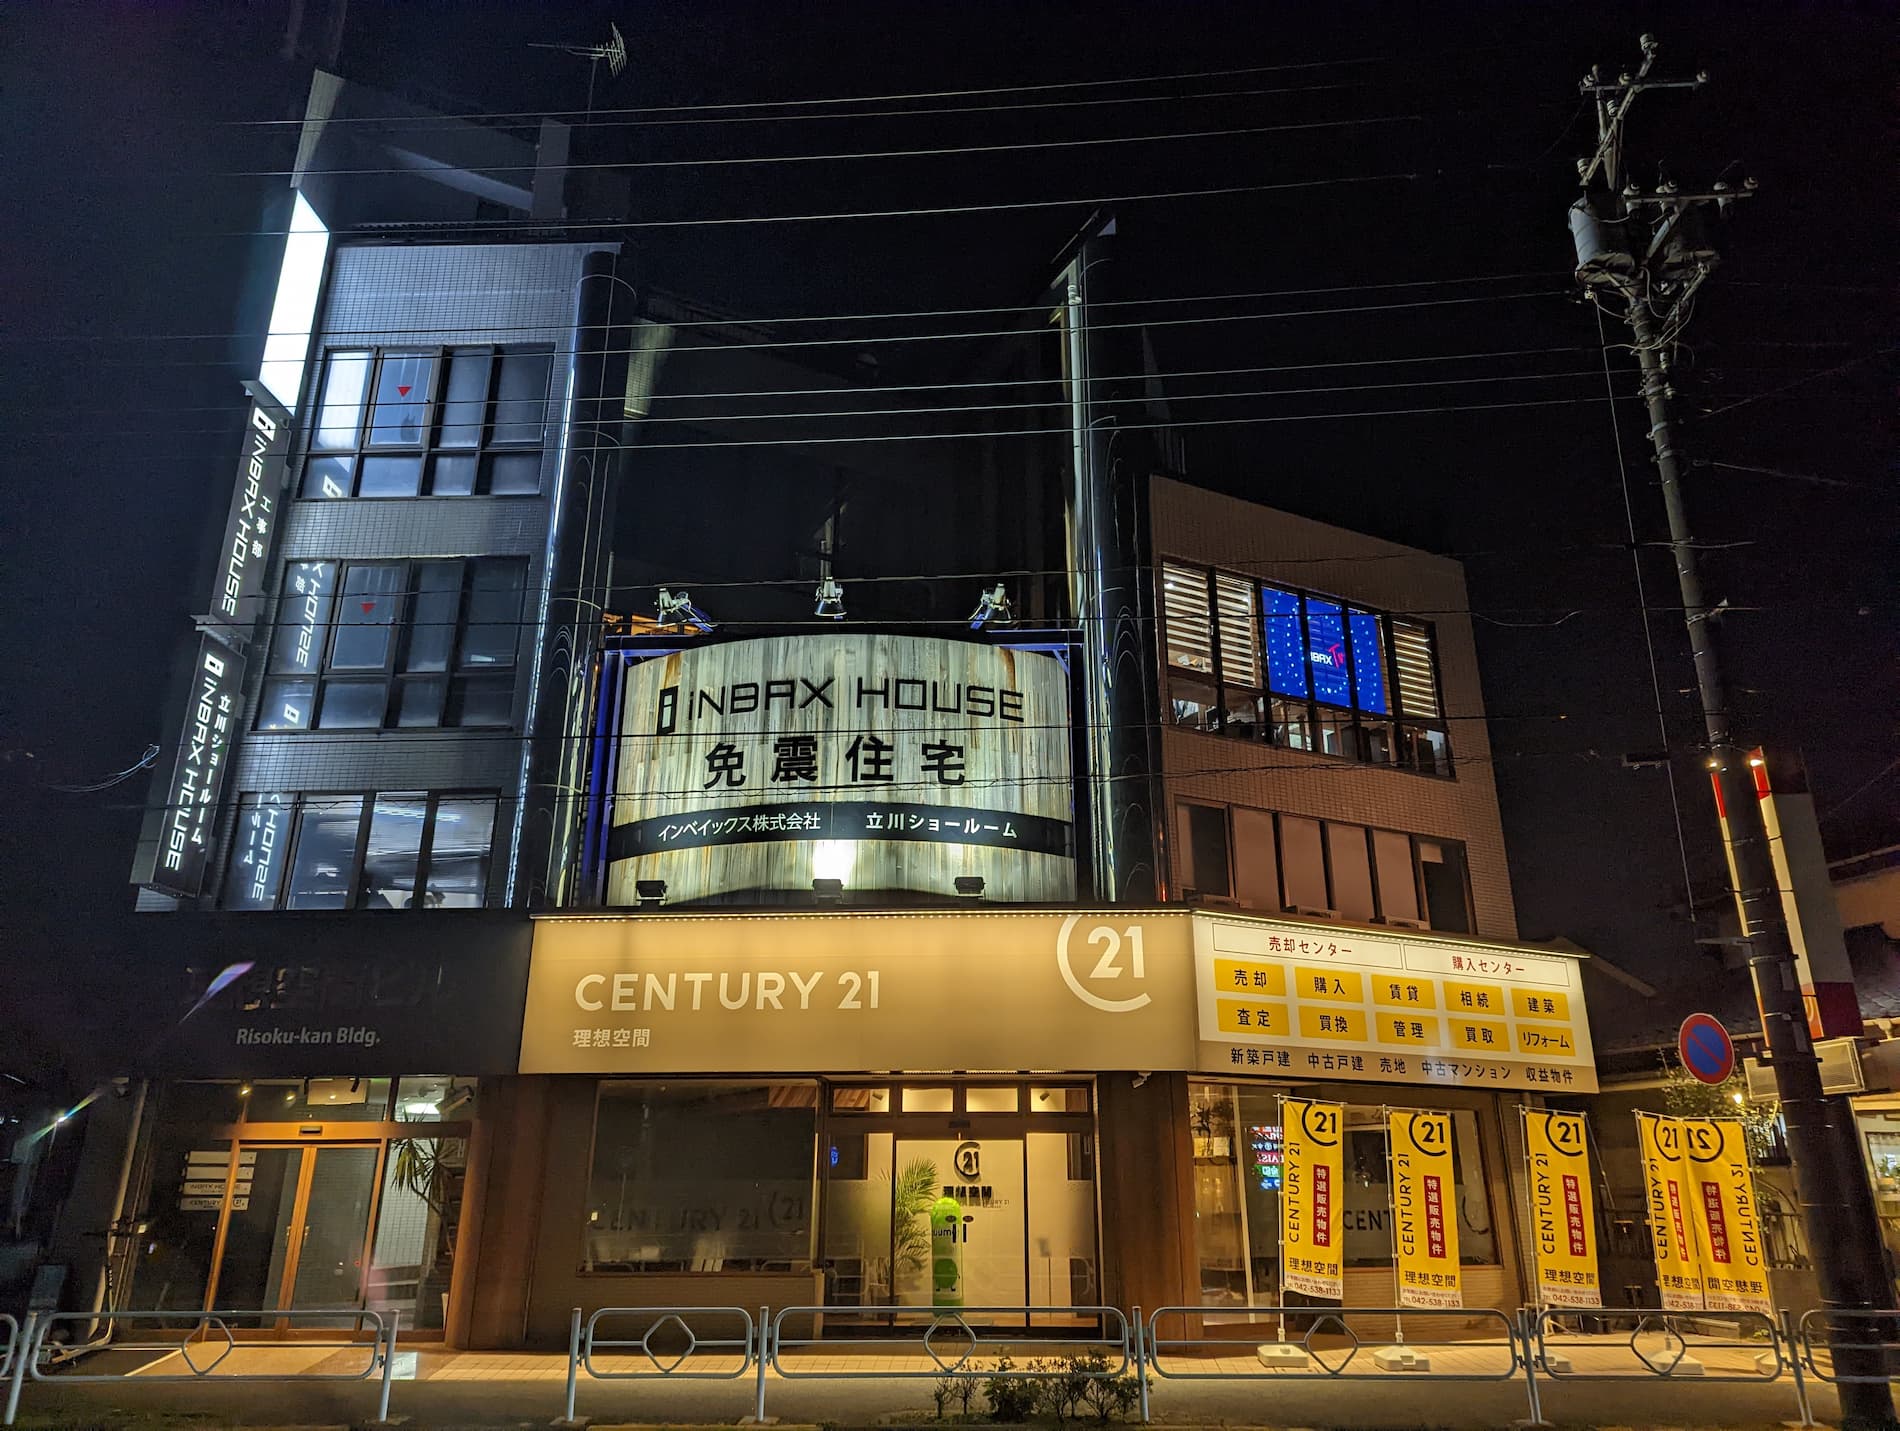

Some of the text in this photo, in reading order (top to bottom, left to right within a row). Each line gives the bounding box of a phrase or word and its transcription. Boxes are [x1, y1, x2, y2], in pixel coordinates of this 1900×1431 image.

[221, 519, 252, 617] HOUSE
[856, 676, 1025, 723] HOUSE
[703, 734, 966, 790] 免震住宅
[165, 768, 198, 871] HOUSE
[658, 811, 1018, 842] インベイックス株式会社 立川ショールーム
[1087, 925, 1145, 979] 21
[1268, 935, 1352, 957] 売却センター
[1451, 955, 1525, 975] 購入センター
[1233, 968, 1267, 988] 売却
[1313, 976, 1346, 995] 購入
[574, 970, 880, 1012] CENTURY 21
[1389, 983, 1419, 1002] 賃貸
[1460, 990, 1489, 1008] 相続
[1527, 997, 1555, 1014] 建築
[1237, 1008, 1271, 1027] 査定
[1319, 1014, 1349, 1033] 買換
[235, 1026, 381, 1047] Risoku-kan Bldg.
[572, 1028, 651, 1048] 理想空間
[1393, 1020, 1425, 1039] 管理
[1465, 1026, 1495, 1044] 買取
[1522, 1031, 1570, 1049] リフォーム
[1230, 1047, 1573, 1084] 新築戸建 中古戸建 売地 中古マンション 収益物件
[1313, 1111, 1337, 1134] 21
[1421, 1121, 1444, 1144] 21
[1557, 1121, 1581, 1144] 21
[1662, 1126, 1679, 1149] 21
[1288, 1142, 1300, 1243] CENTURY 21
[1535, 1153, 1555, 1254] CENTURY 21
[1398, 1153, 1415, 1256] CENTURY 21
[1650, 1178, 1668, 1260] CENTURY
[1288, 1257, 1338, 1276] 理想空間
[1404, 1270, 1457, 1288] 理想空間
